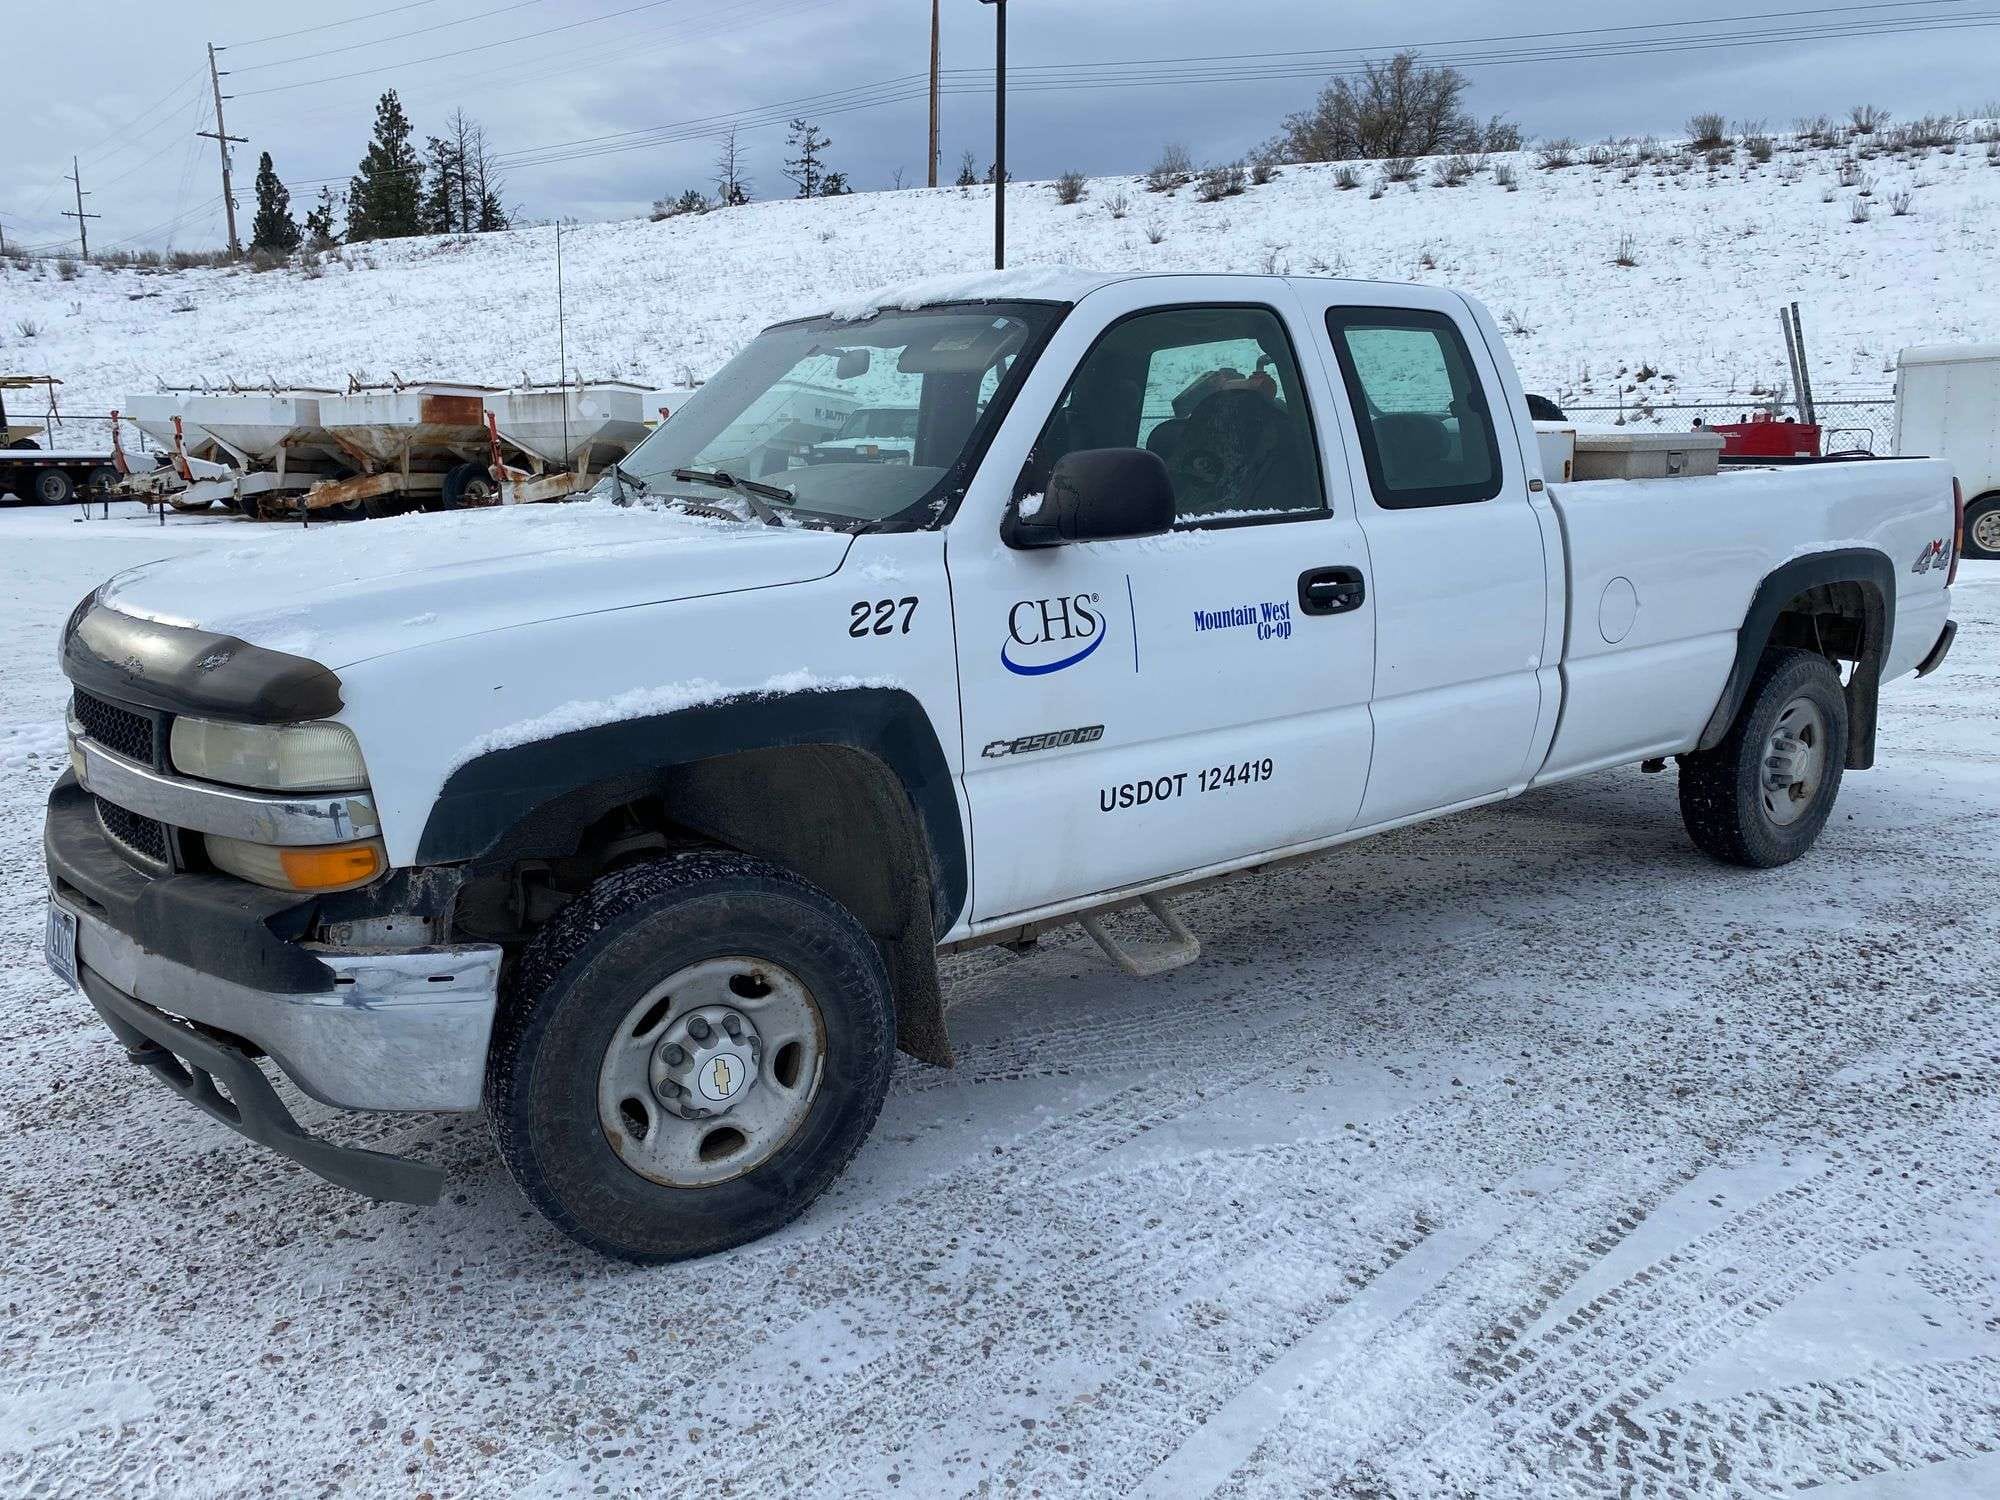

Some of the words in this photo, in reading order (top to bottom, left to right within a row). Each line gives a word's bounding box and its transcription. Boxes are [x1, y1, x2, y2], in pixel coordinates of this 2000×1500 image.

[849, 596, 919, 638] 227
[1193, 605, 1257, 632] Mountain
[1260, 600, 1290, 623] West
[1257, 621, 1291, 641] Co-op
[1100, 773, 1188, 812] USDOT
[1198, 758, 1273, 792] 124419
